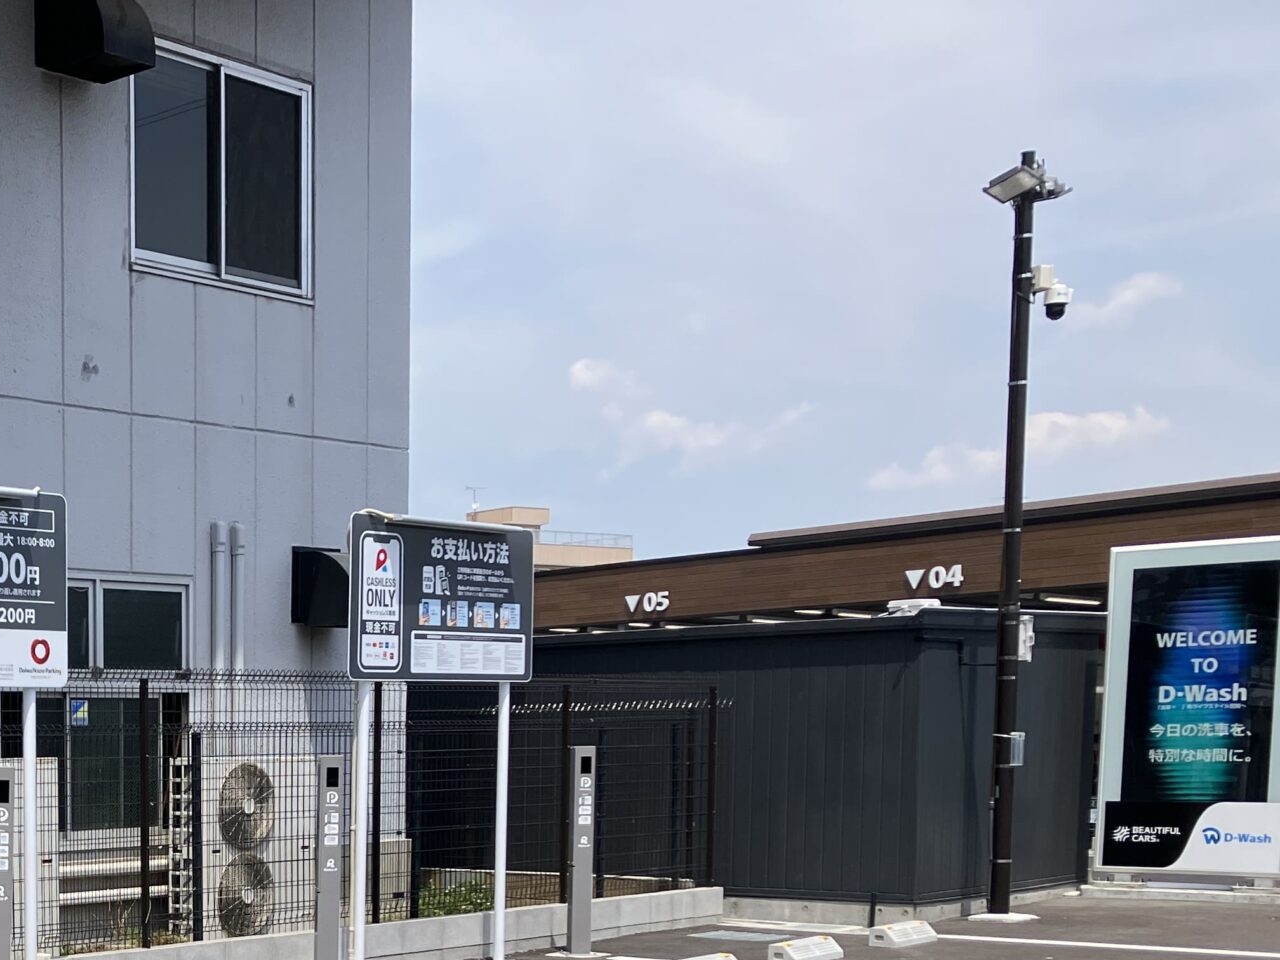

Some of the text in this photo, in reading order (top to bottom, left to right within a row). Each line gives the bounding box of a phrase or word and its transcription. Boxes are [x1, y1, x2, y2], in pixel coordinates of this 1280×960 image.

[17, 536, 55, 548] 18:00-8:00
[431, 537, 509, 564] お支払い方法
[366, 576, 396, 588] CASHLESS
[929, 564, 964, 588] 04
[366, 588, 396, 608] ONLY
[643, 591, 670, 612] 05
[365, 621, 396, 634] 現金不可
[1156, 629, 1257, 648] WELCOME
[1190, 657, 1219, 673] TO
[1158, 683, 1248, 703] D-Wash
[1150, 723, 1252, 738] 今日の洗車を、
[1148, 748, 1252, 763] 特別な時間に。
[1131, 826, 1181, 835] BEAUTIFUL
[1224, 832, 1272, 844] D-Wash
